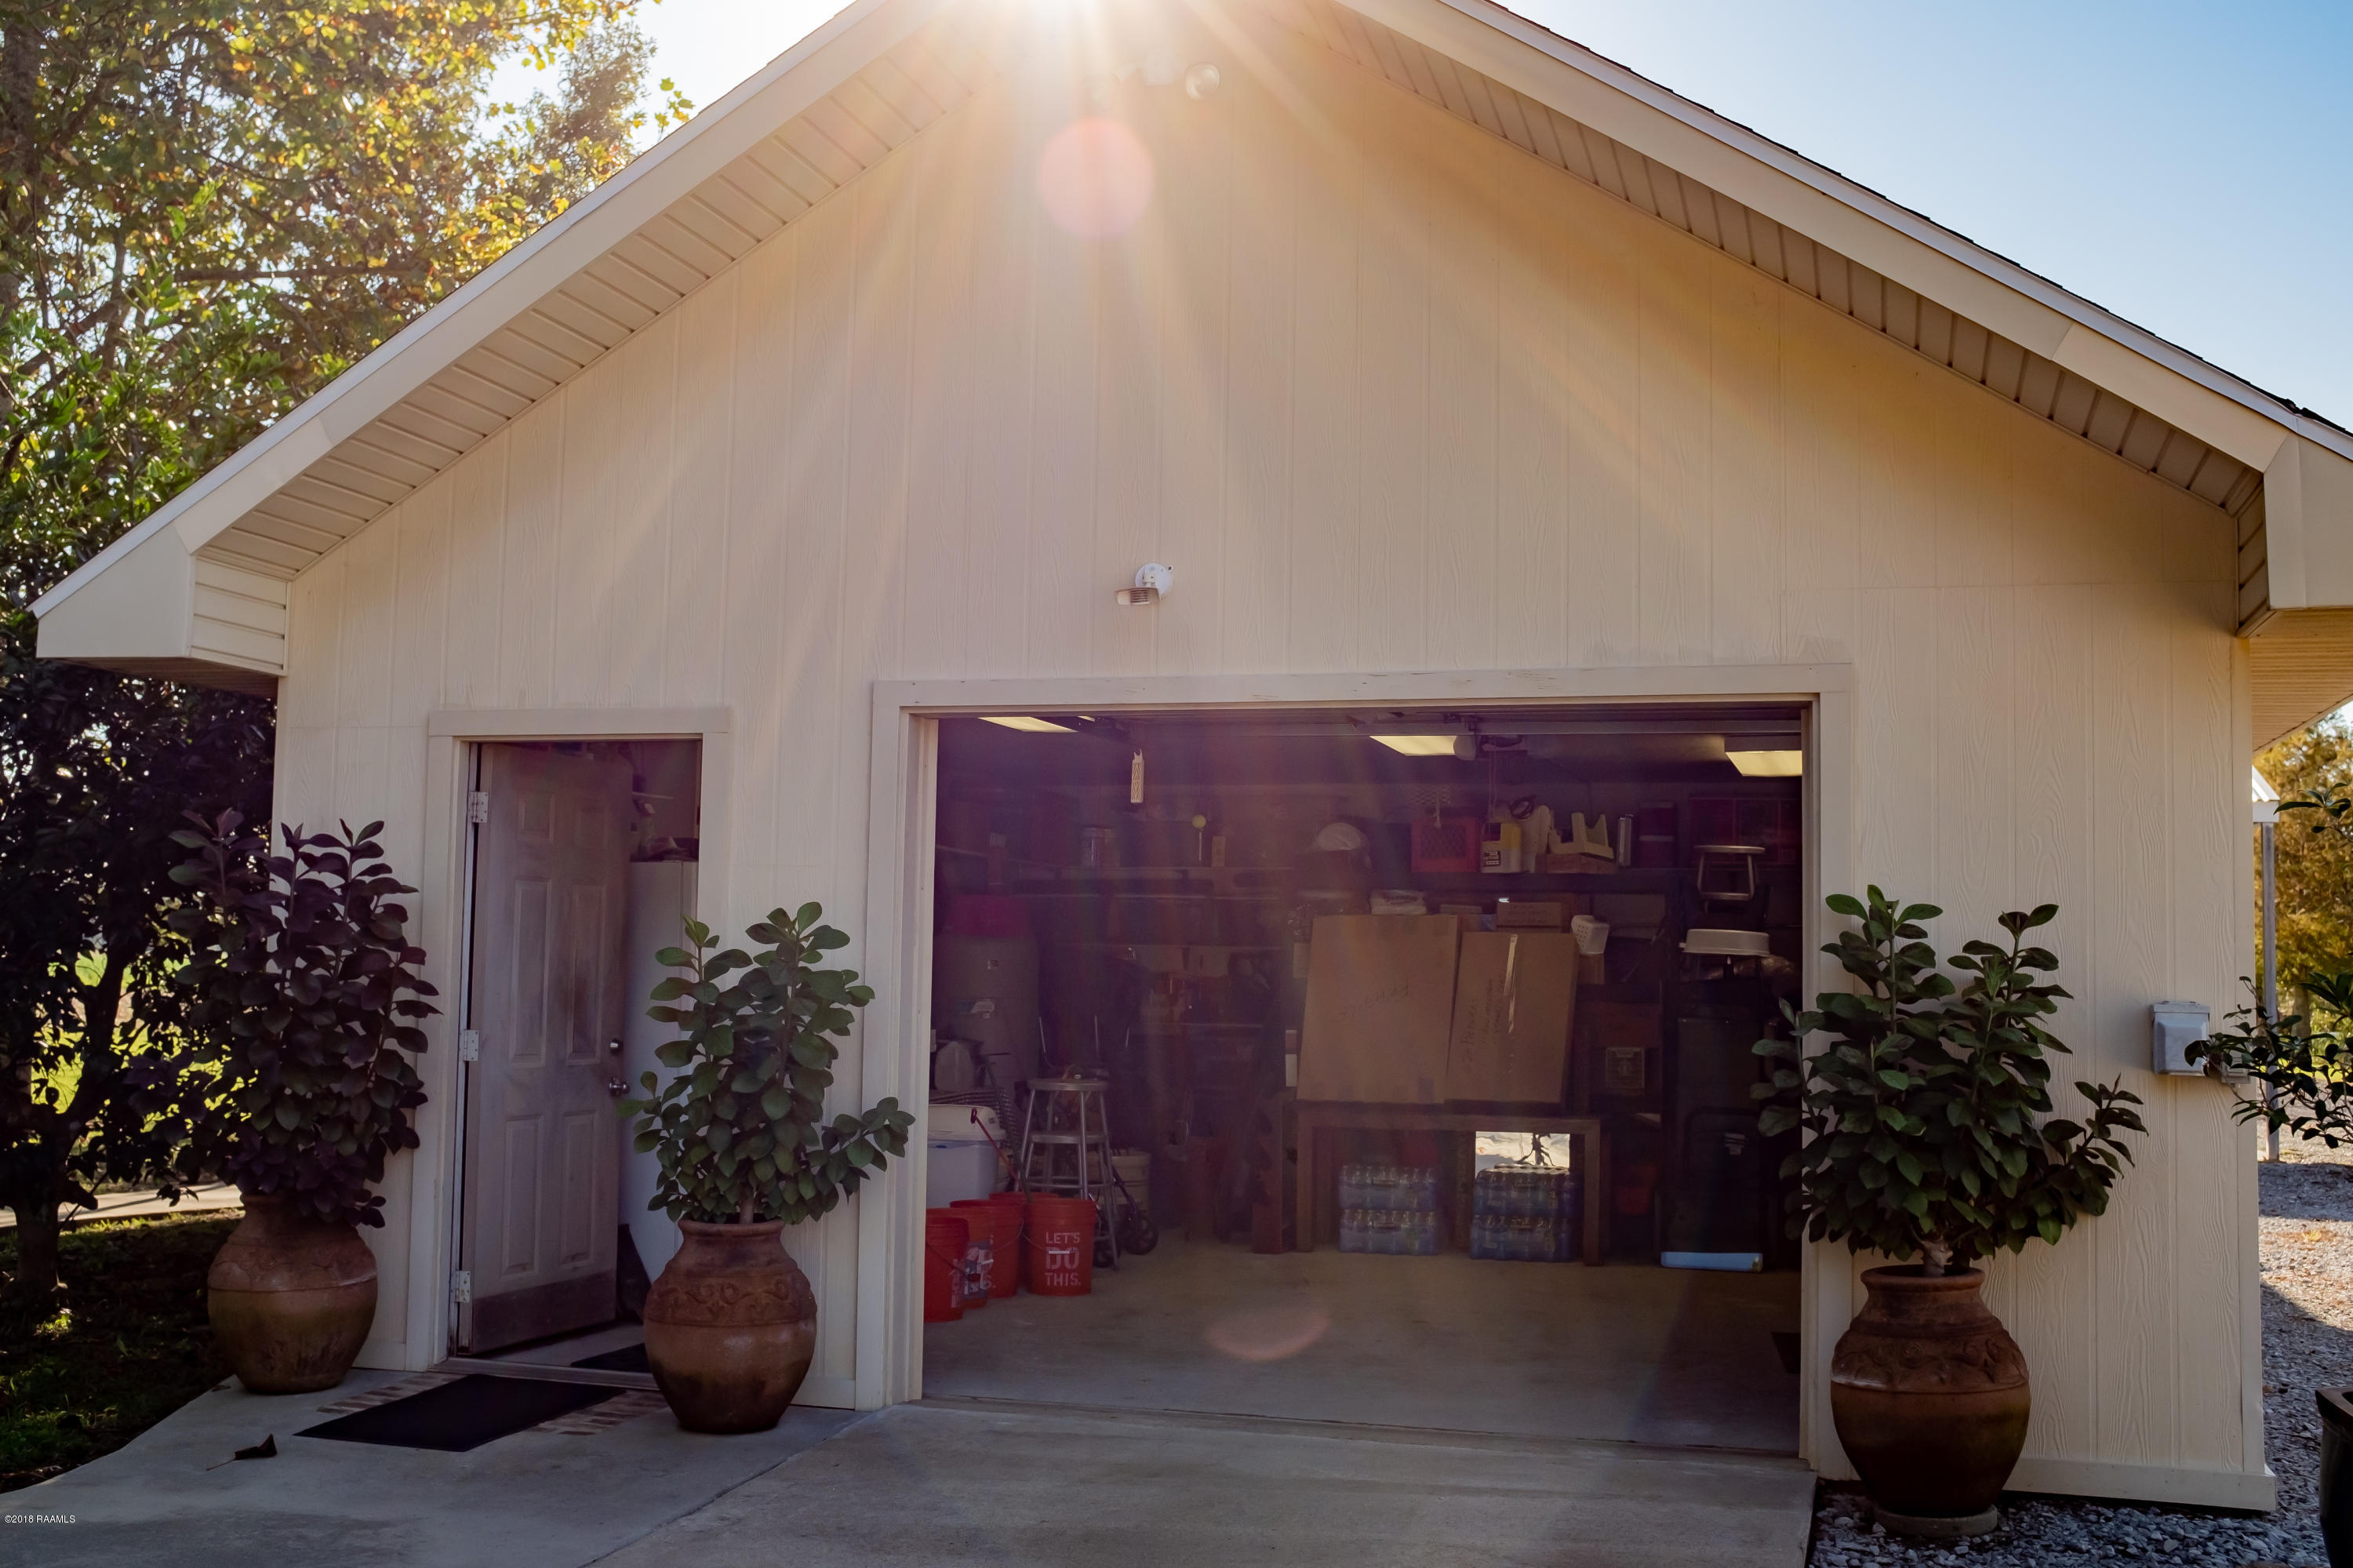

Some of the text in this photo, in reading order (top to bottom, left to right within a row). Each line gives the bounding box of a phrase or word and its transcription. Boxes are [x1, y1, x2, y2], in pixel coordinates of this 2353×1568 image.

[1046, 1232, 1080, 1244] LET'S
[1046, 1246, 1080, 1269] DO
[1045, 1272, 1082, 1286] THIS.
